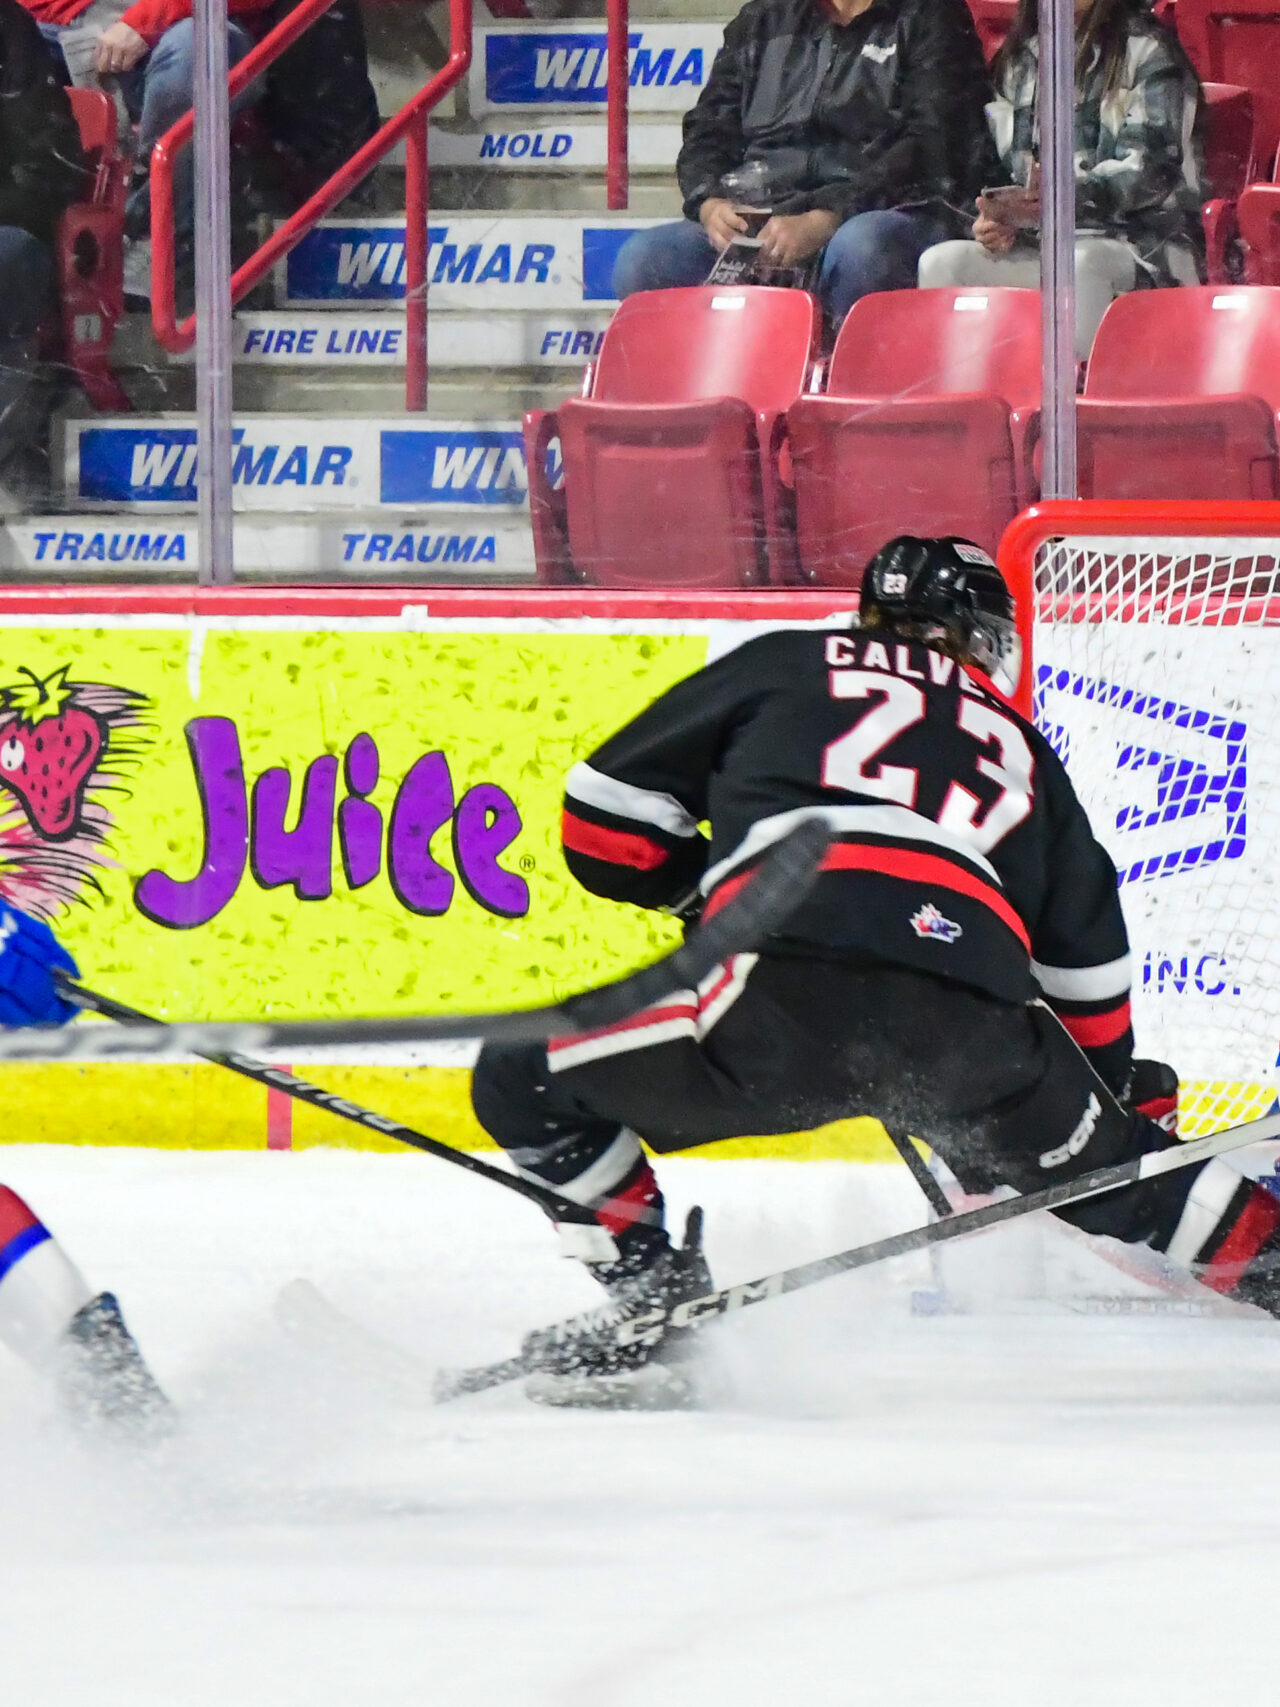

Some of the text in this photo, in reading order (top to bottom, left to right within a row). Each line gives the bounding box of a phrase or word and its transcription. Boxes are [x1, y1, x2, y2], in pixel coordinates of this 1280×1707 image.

[534, 47, 722, 88] WIMA
[478, 133, 573, 158] MOLD
[336, 242, 555, 285] WIMAR
[243, 329, 402, 354] FIRE LINE
[130, 444, 353, 486] WIMAR
[33, 532, 187, 562] TRAUMA
[342, 533, 496, 563] TRAUMA
[825, 635, 1004, 709] CALVE
[821, 670, 1035, 855] 23
[134, 715, 531, 931] Juice
[617, 1274, 785, 1347] CCM
